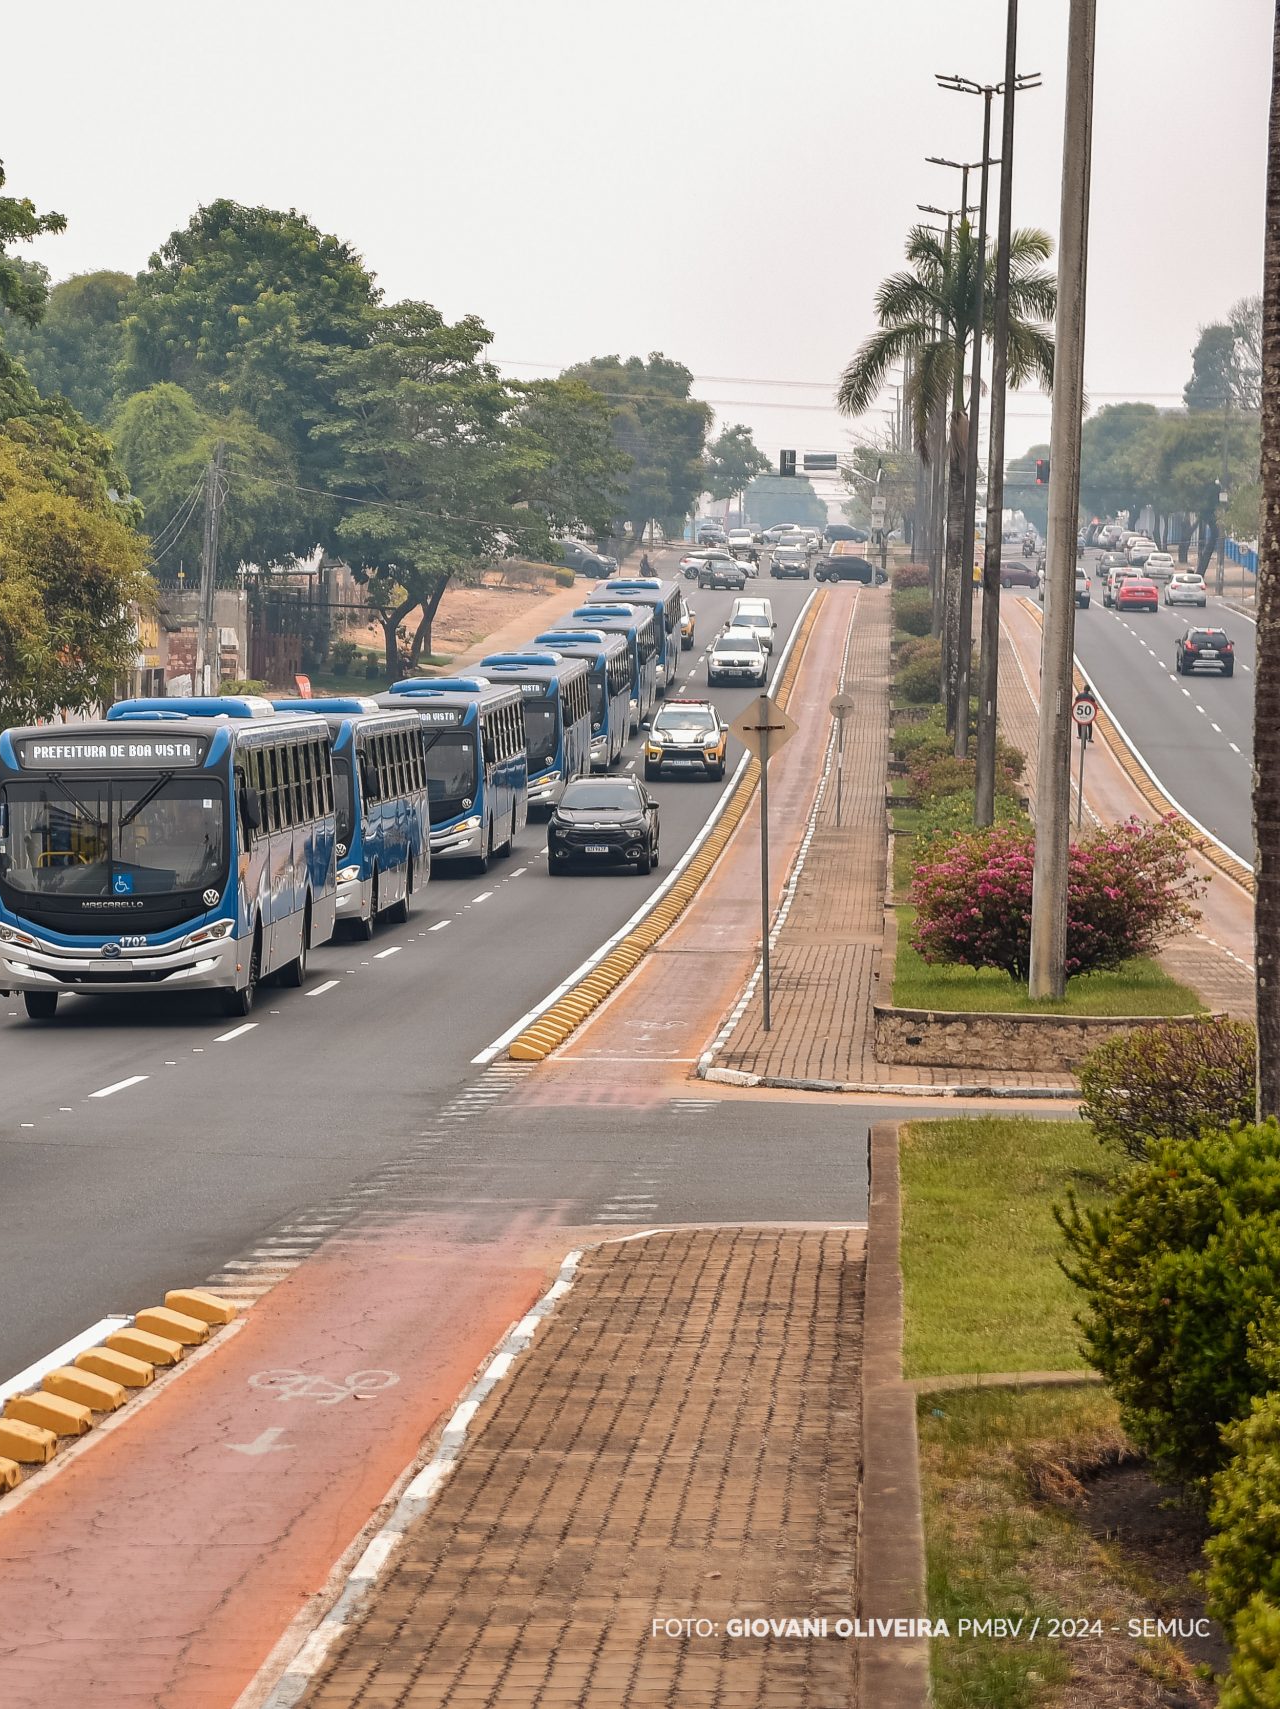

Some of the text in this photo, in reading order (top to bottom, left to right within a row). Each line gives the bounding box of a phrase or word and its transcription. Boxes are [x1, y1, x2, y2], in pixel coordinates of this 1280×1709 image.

[1077, 705, 1092, 715] 50
[433, 712, 455, 721] VISTA
[33, 744, 191, 759] PREFEITURA DE BOA VISTA
[81, 901, 144, 909] MASCARELLO
[119, 936, 147, 946] 1702
